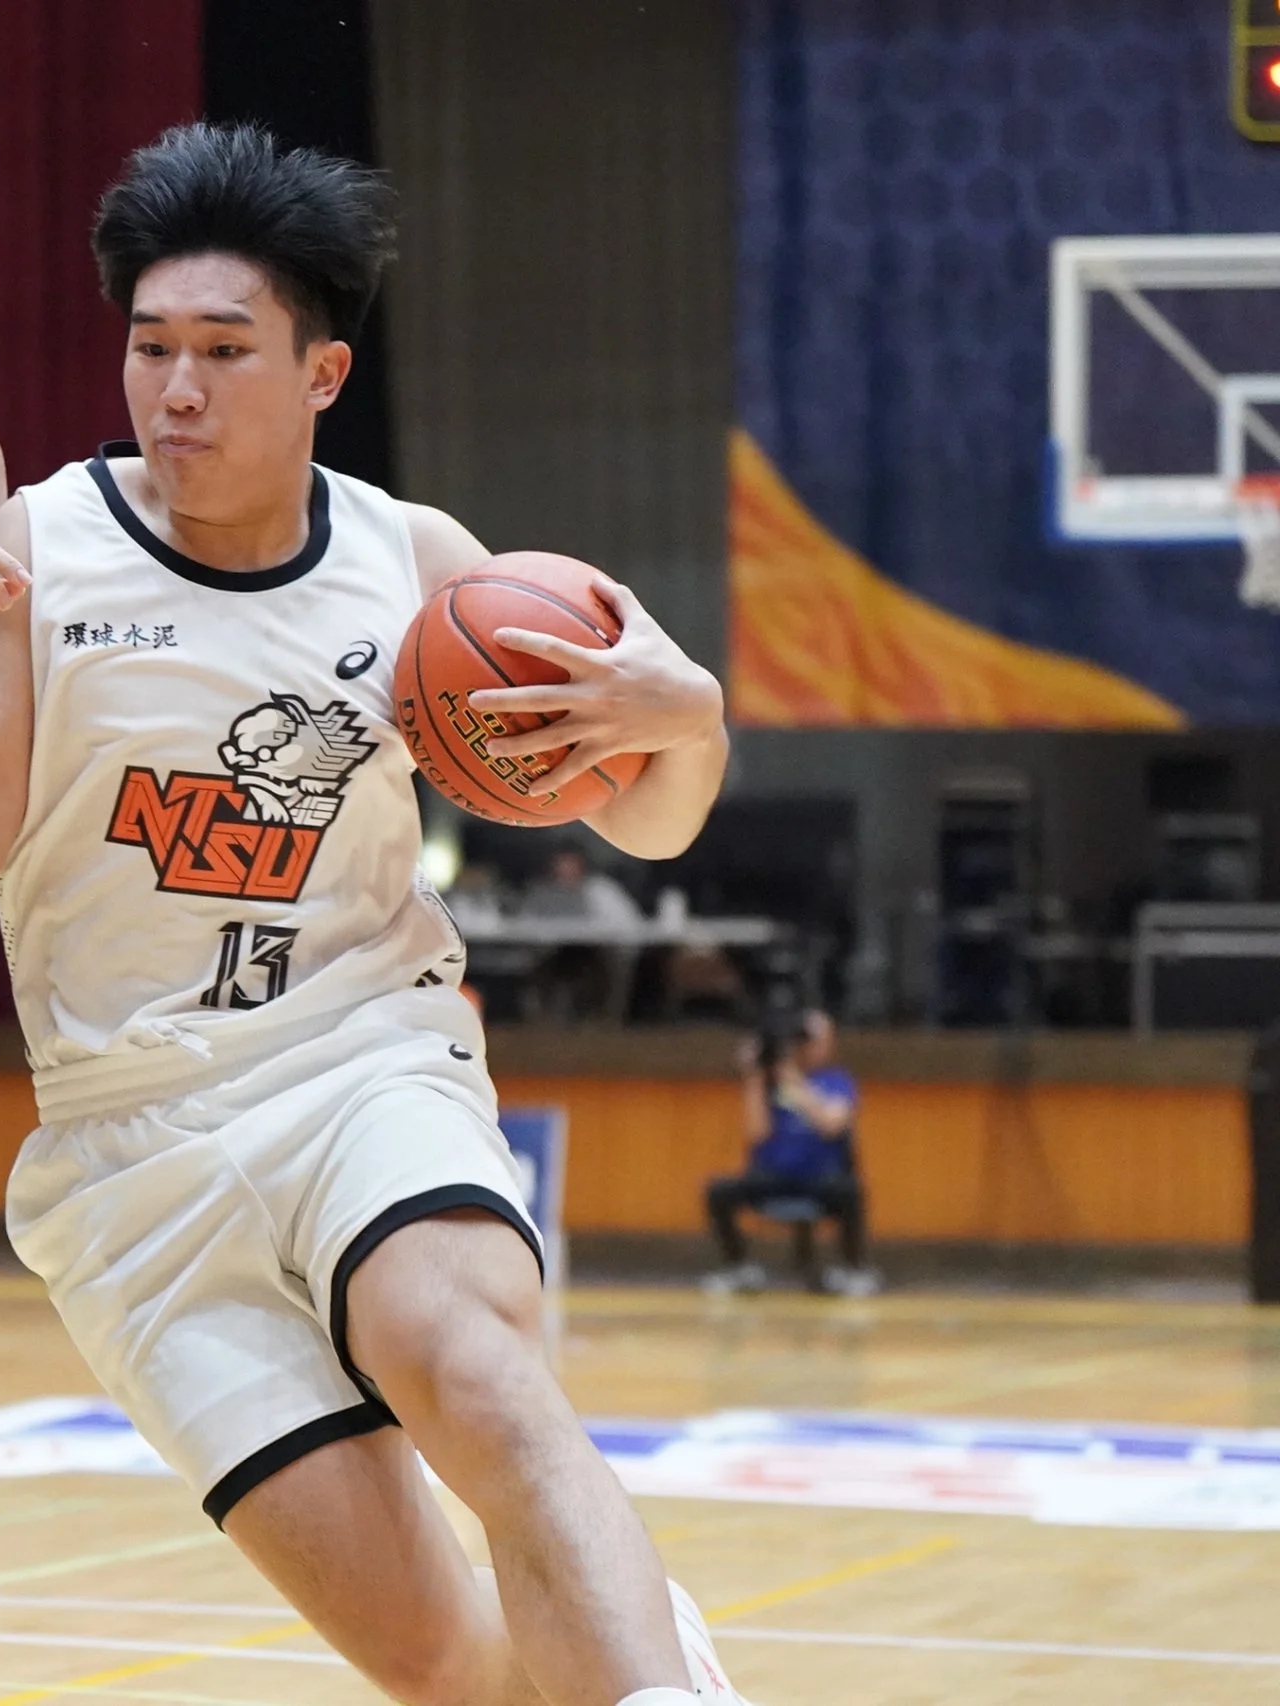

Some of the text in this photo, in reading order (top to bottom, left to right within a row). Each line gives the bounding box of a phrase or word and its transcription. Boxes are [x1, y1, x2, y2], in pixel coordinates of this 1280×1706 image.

[63, 621, 179, 649] 環球水泥
[105, 765, 327, 904] NTSU
[199, 921, 303, 1011] 13
